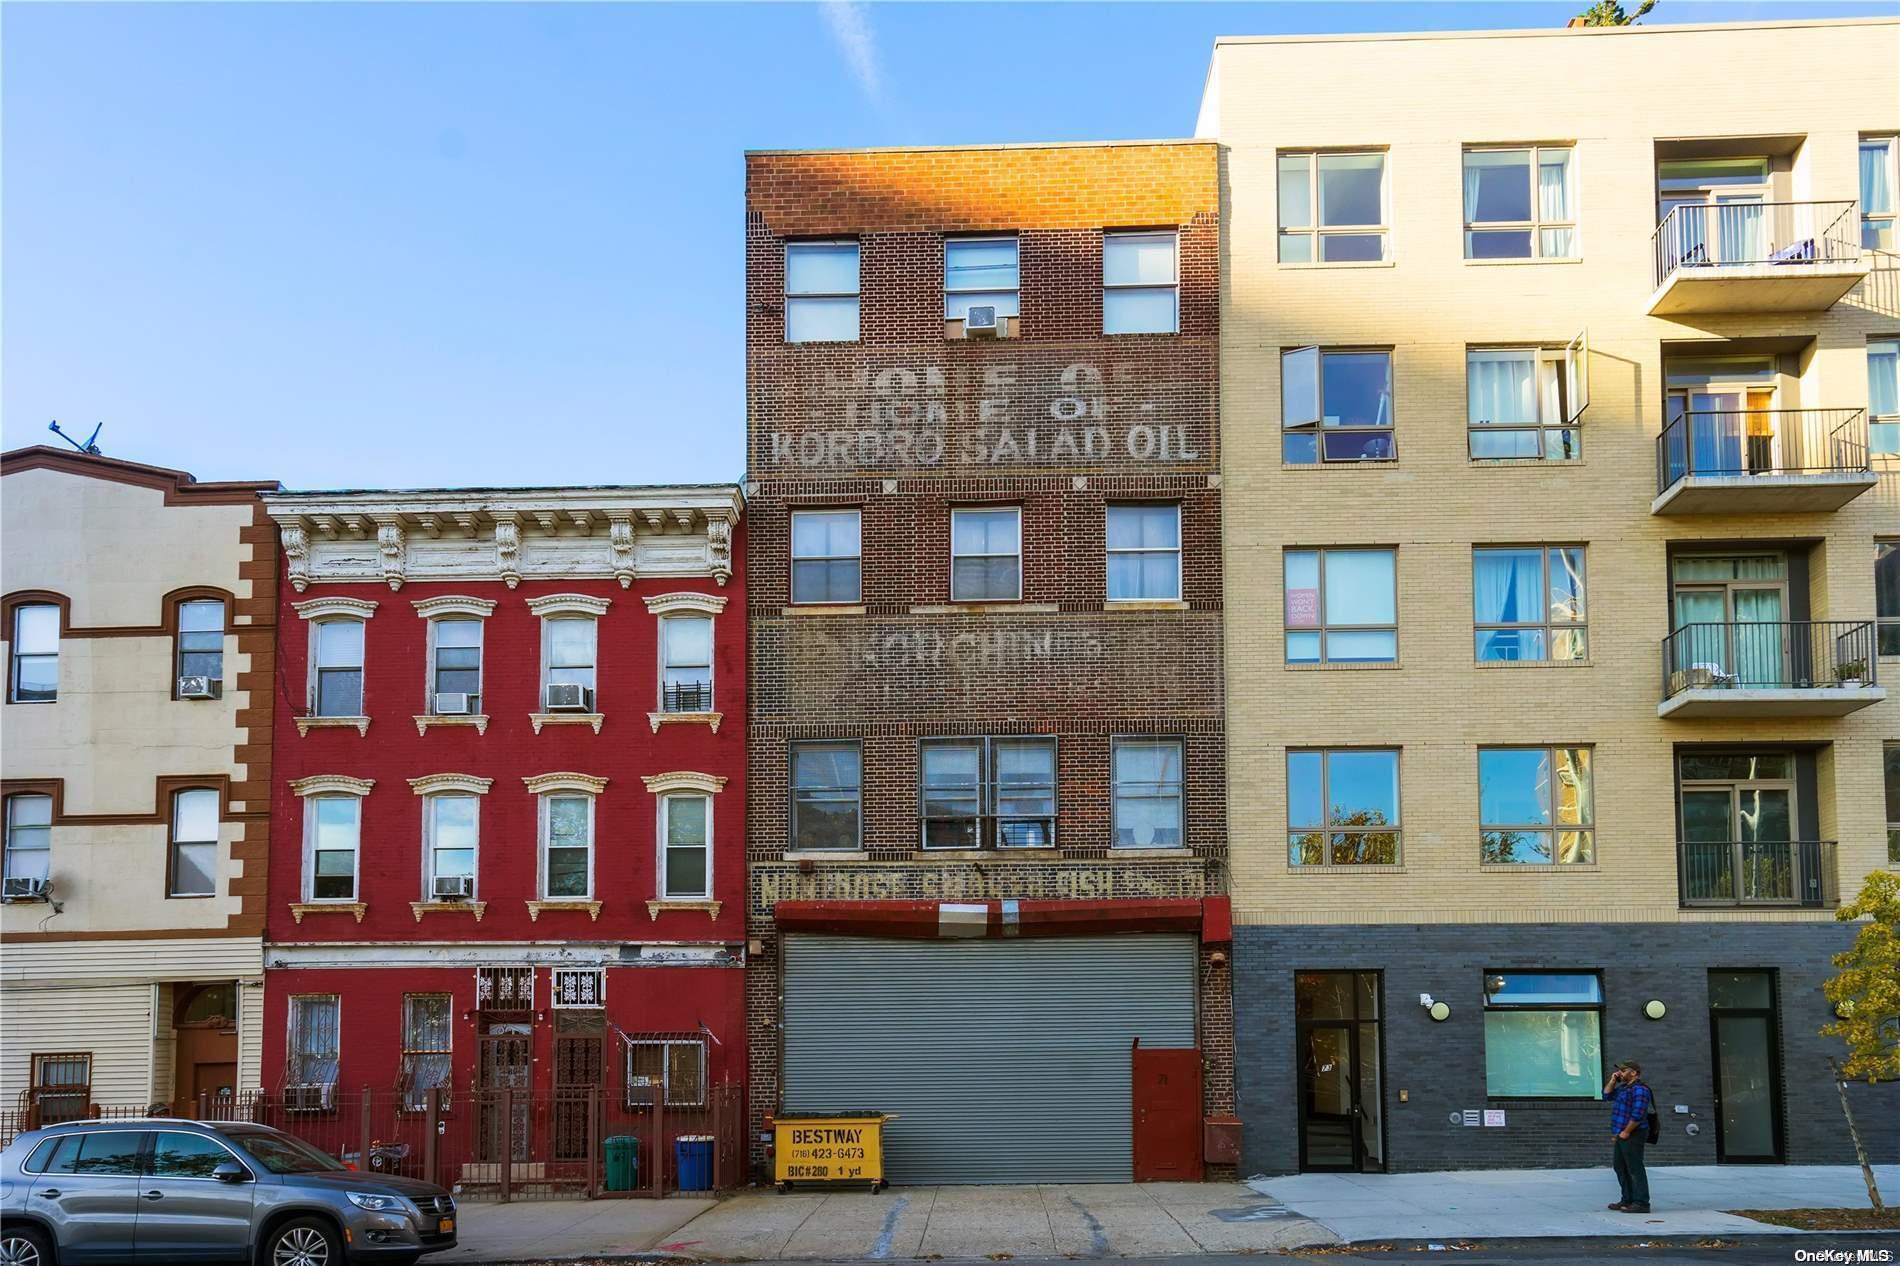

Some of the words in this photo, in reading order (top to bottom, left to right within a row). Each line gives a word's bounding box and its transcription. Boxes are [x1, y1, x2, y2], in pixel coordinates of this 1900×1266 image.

[771, 430, 944, 466] KORBRO
[962, 425, 1111, 464] SALAD
[1126, 424, 1199, 461] OIL
[1056, 870, 1113, 899] FISH
[792, 1129, 862, 1144] BESTWAY
[811, 1147, 864, 1159] 423-6473
[838, 1166, 843, 1175] 1
[848, 1166, 861, 1177] yd
